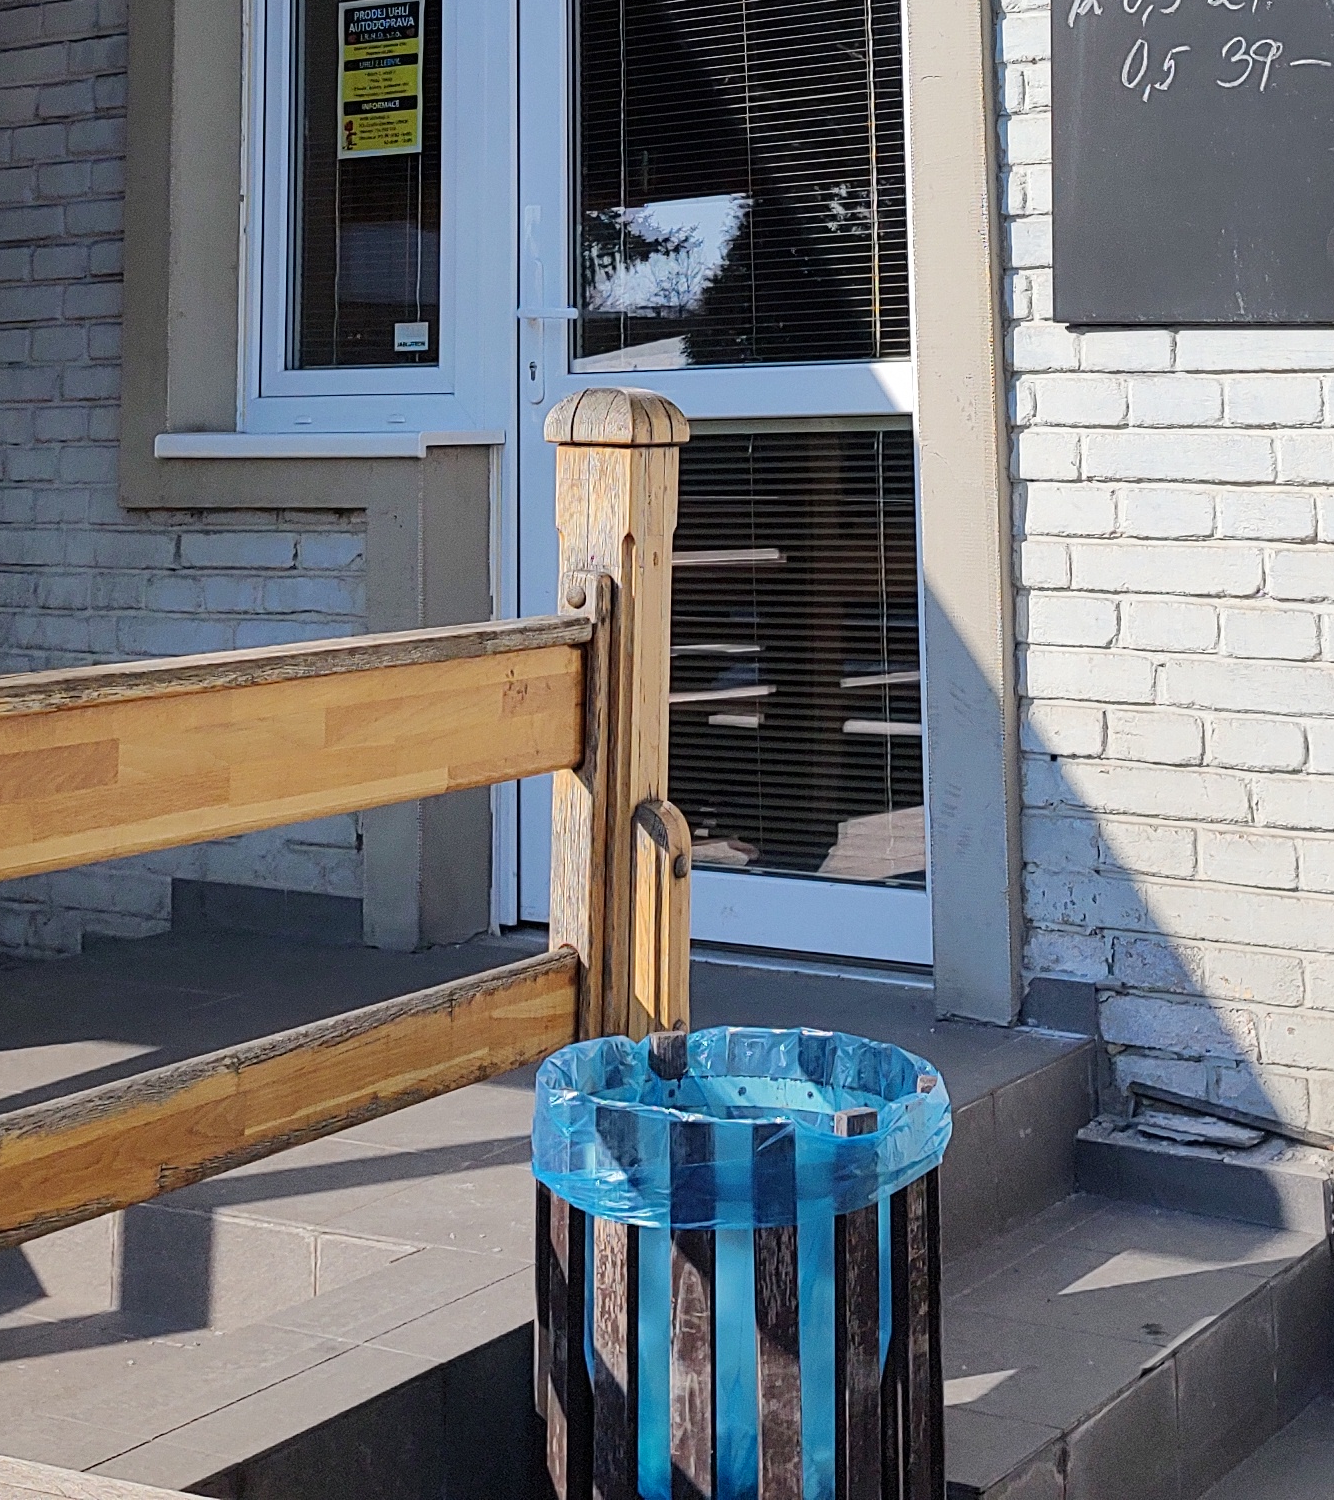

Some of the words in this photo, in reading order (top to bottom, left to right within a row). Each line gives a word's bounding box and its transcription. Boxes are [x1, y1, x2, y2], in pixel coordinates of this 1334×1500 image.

[354, 7, 386, 20] PRODEJ
[388, 2, 410, 17] UHLÍ
[348, 16, 415, 33] AUTODOPRAVA
[1122, 38, 1192, 102] 0,5
